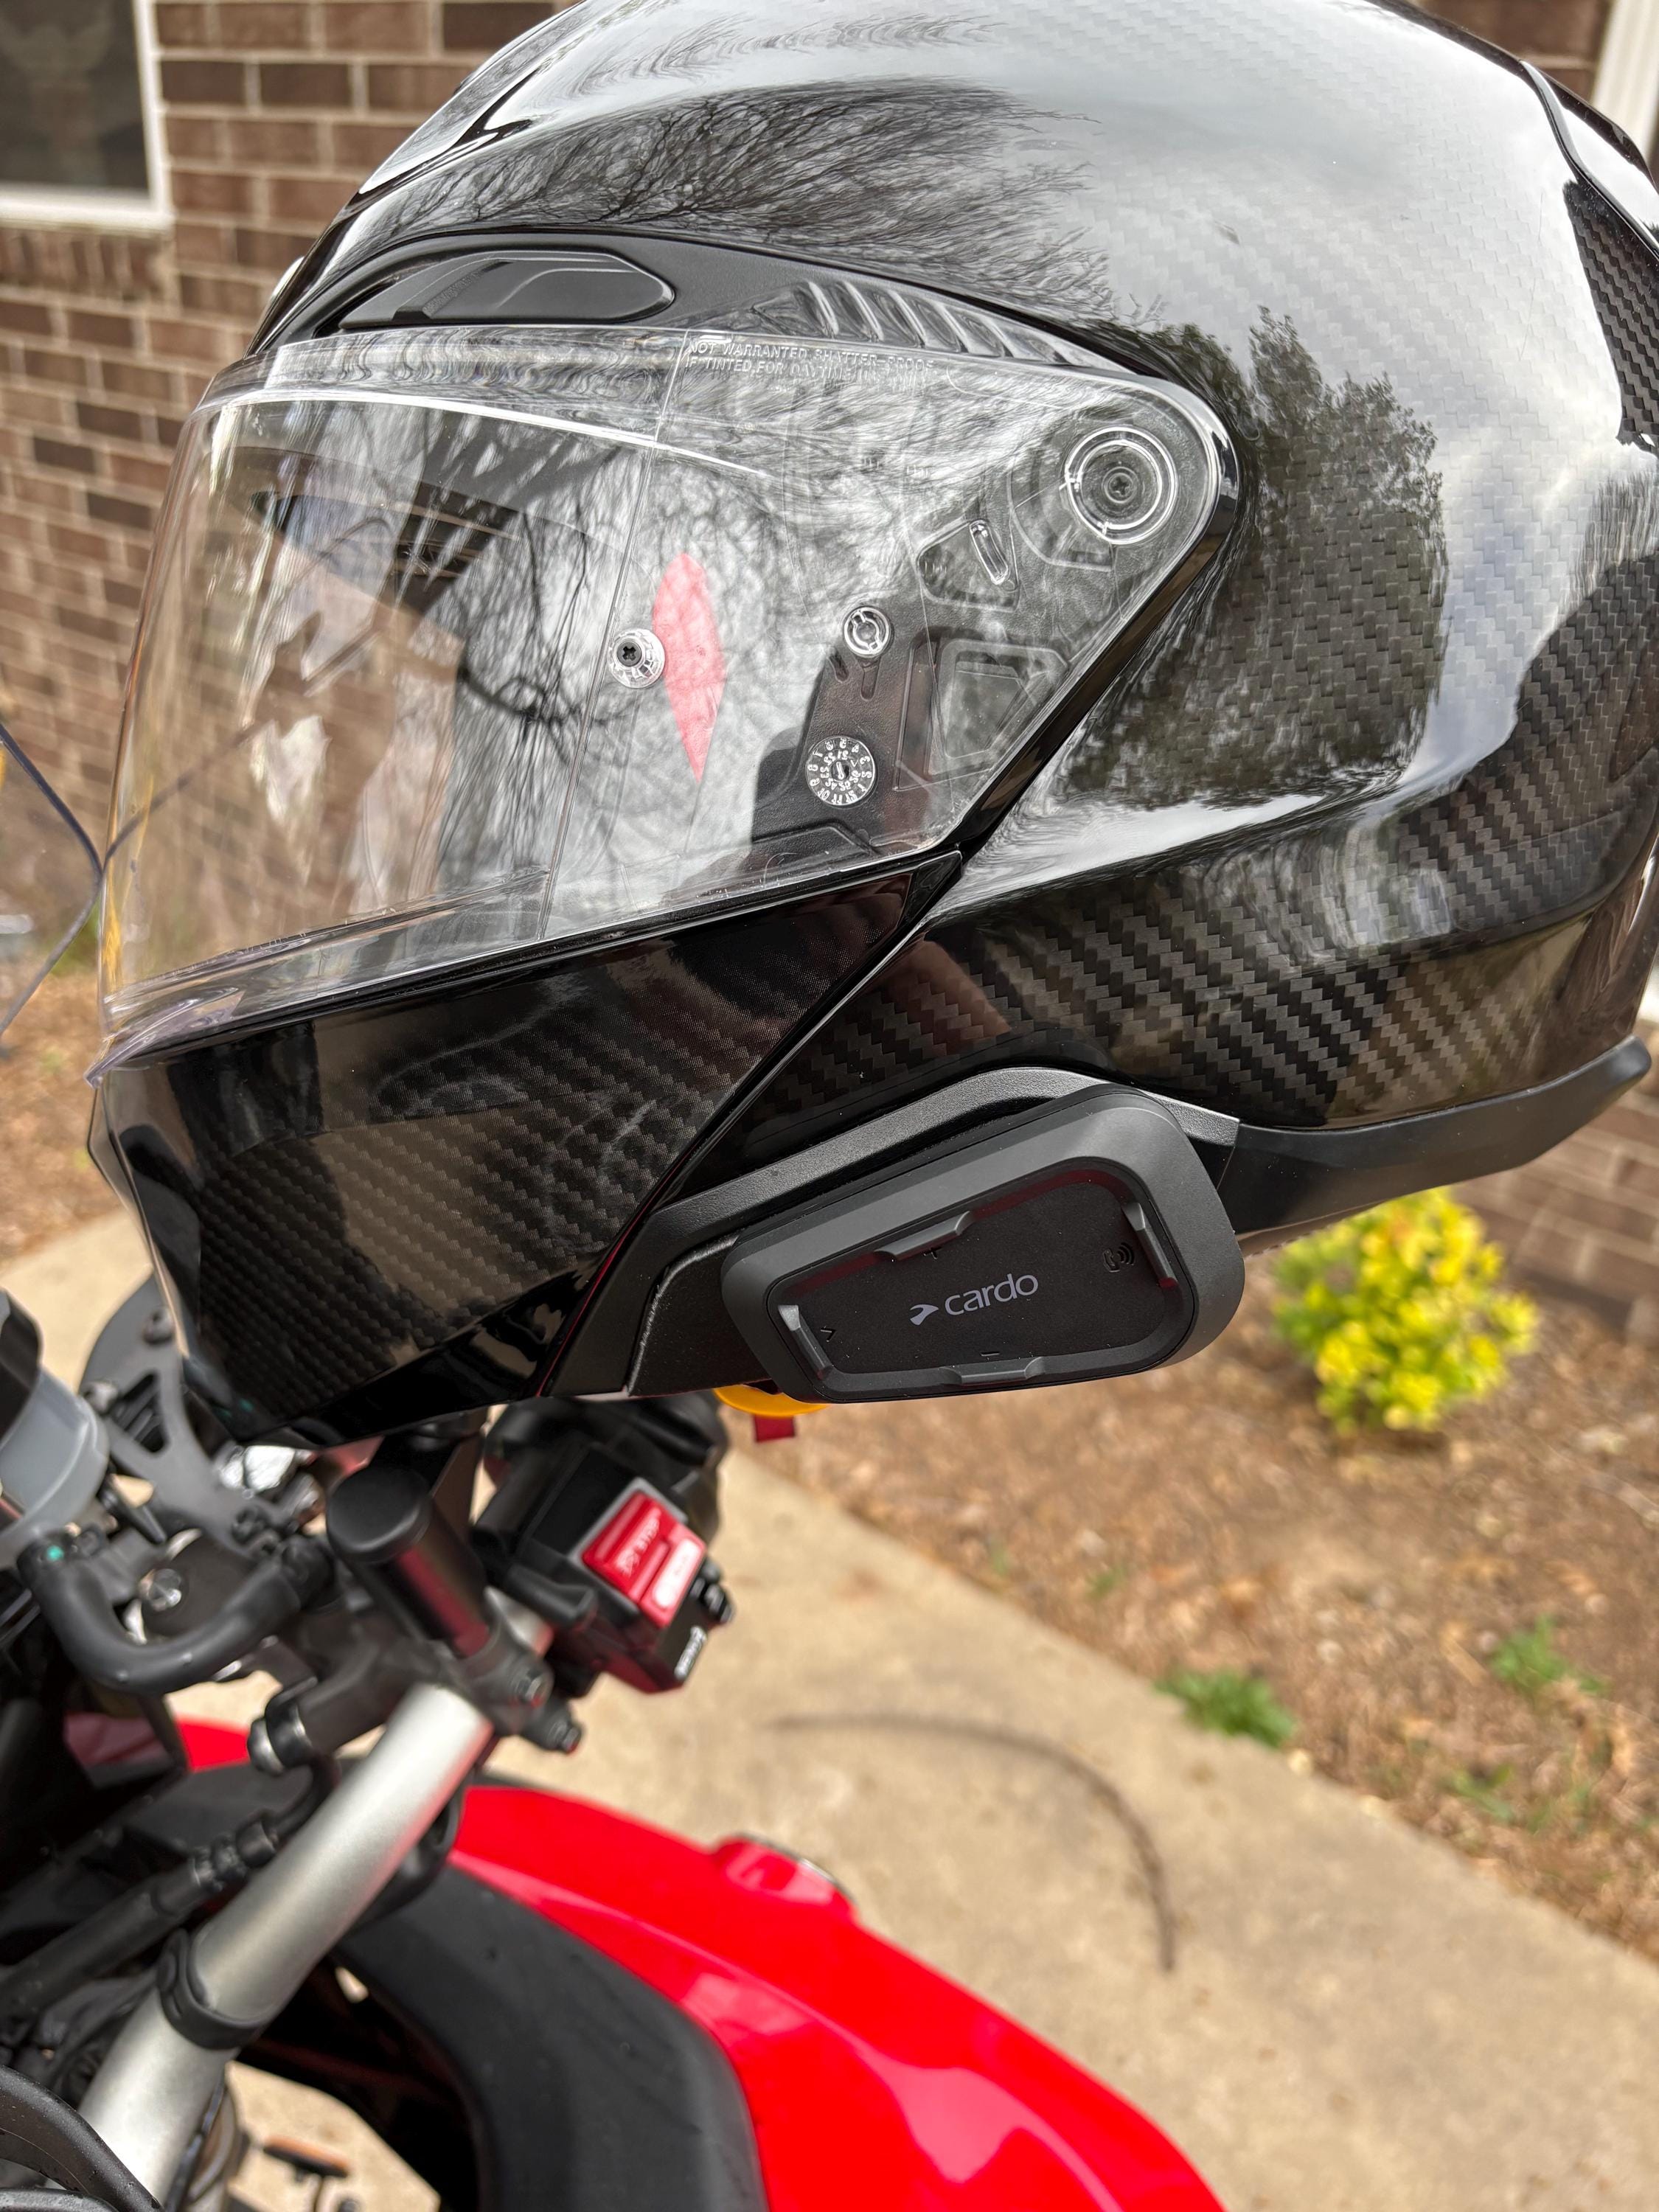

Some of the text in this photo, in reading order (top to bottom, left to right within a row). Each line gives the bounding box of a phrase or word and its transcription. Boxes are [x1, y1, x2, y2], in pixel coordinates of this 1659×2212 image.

[689, 341, 717, 355] NOT
[723, 343, 807, 359] WARRANTED
[685, 355, 698, 368] IF
[757, 361, 784, 375] FOR
[945, 1273, 1038, 1315] cardo
